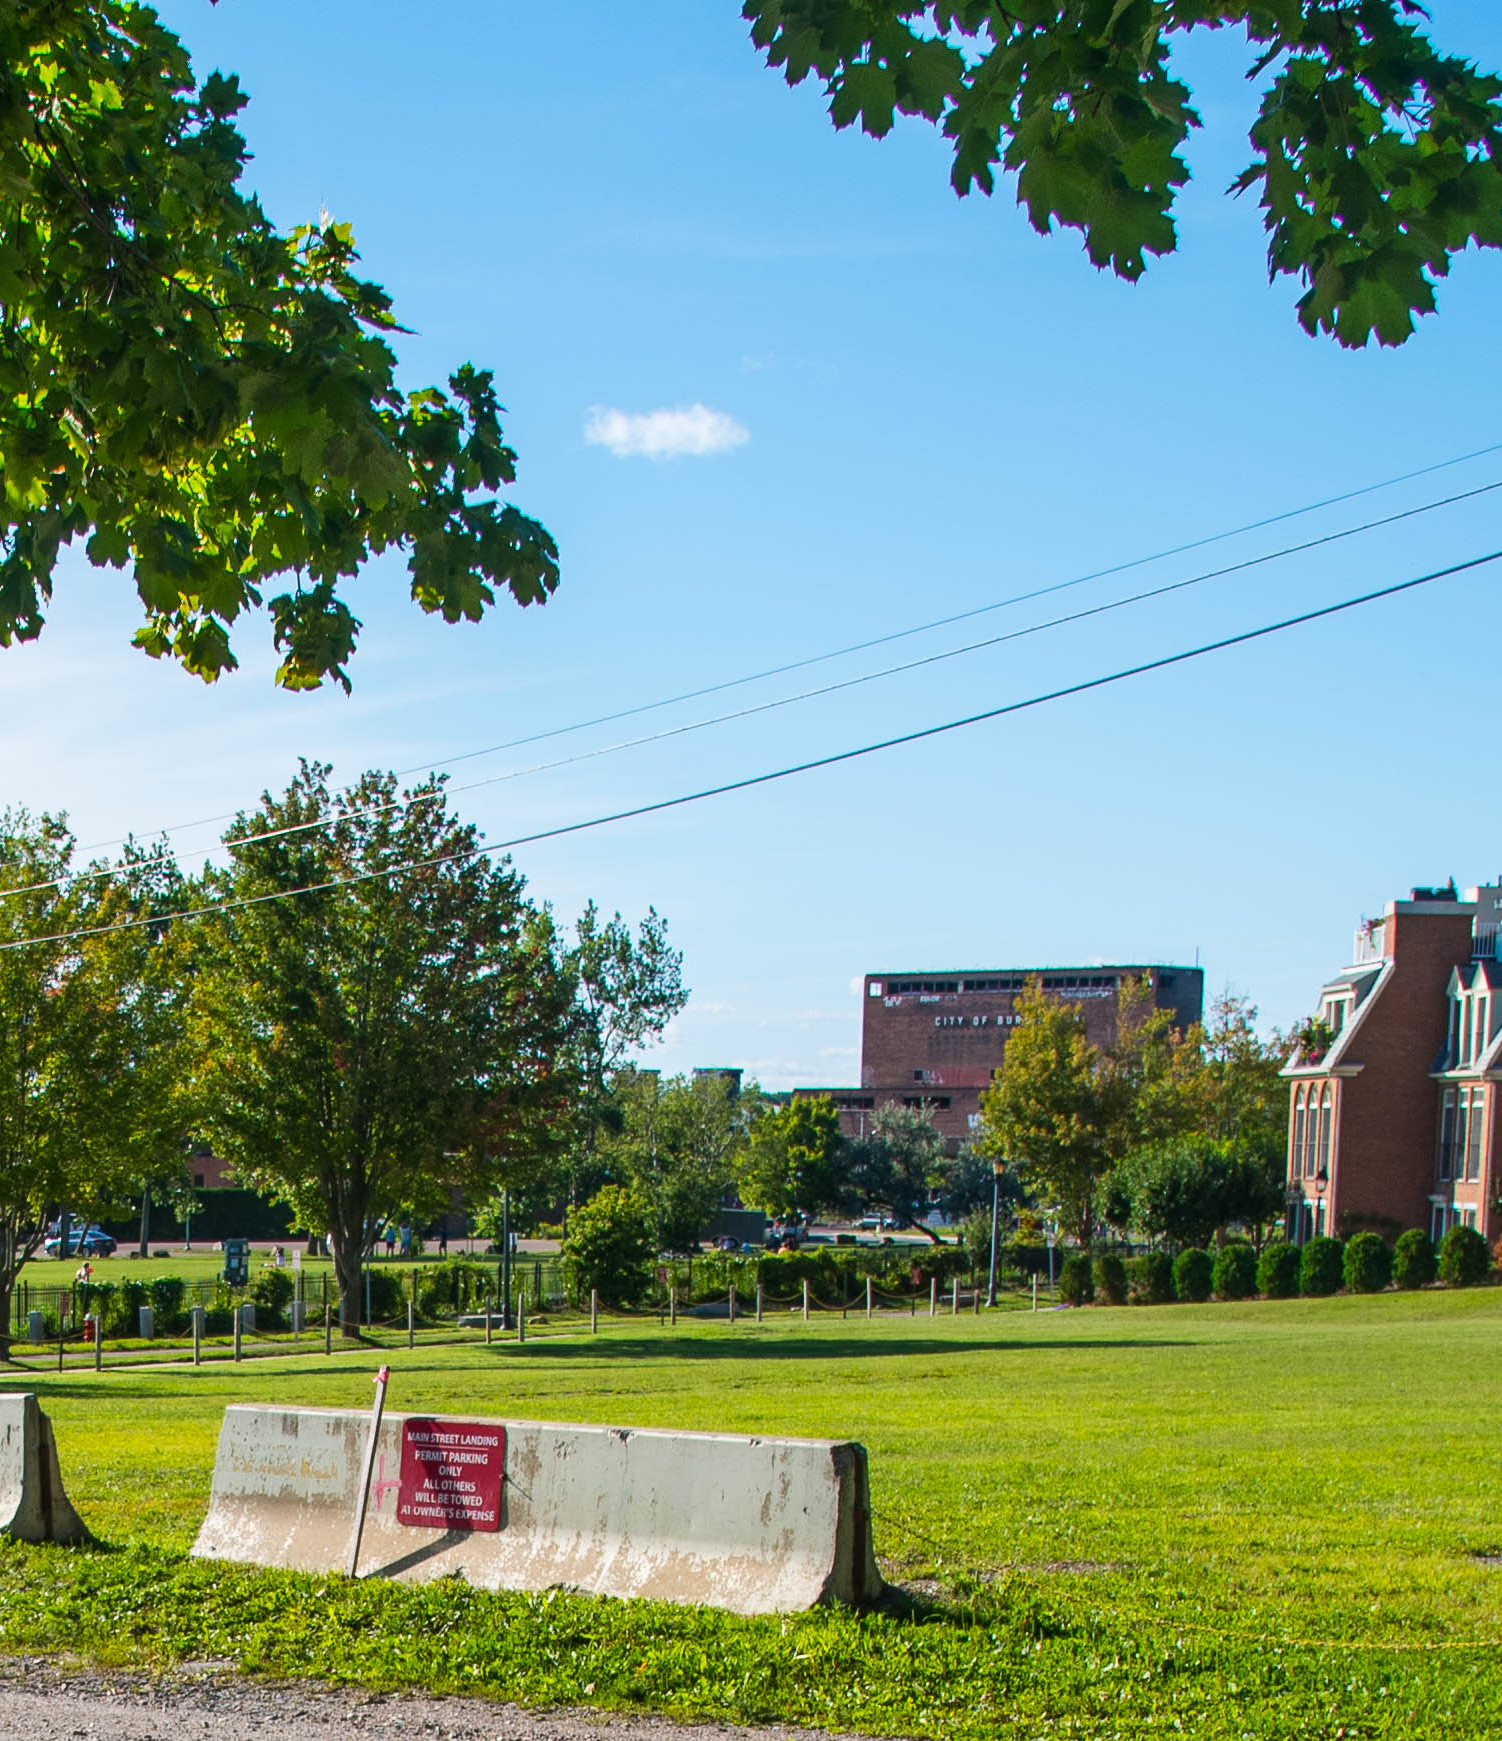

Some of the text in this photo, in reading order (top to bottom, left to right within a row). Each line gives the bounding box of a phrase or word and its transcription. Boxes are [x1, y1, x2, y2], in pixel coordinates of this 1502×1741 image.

[935, 1015, 963, 1026] CITY
[973, 1015, 987, 1026] OF
[408, 1432, 498, 1446] MAIN STREET LANDING
[415, 1450, 488, 1464] PERMIT PARKING
[439, 1465, 462, 1477] ONLY
[423, 1478, 476, 1491] ALL OTHERS
[415, 1492, 482, 1506] WILL BE TOWED
[401, 1505, 495, 1521] AT OWNER'S EXPENSE
